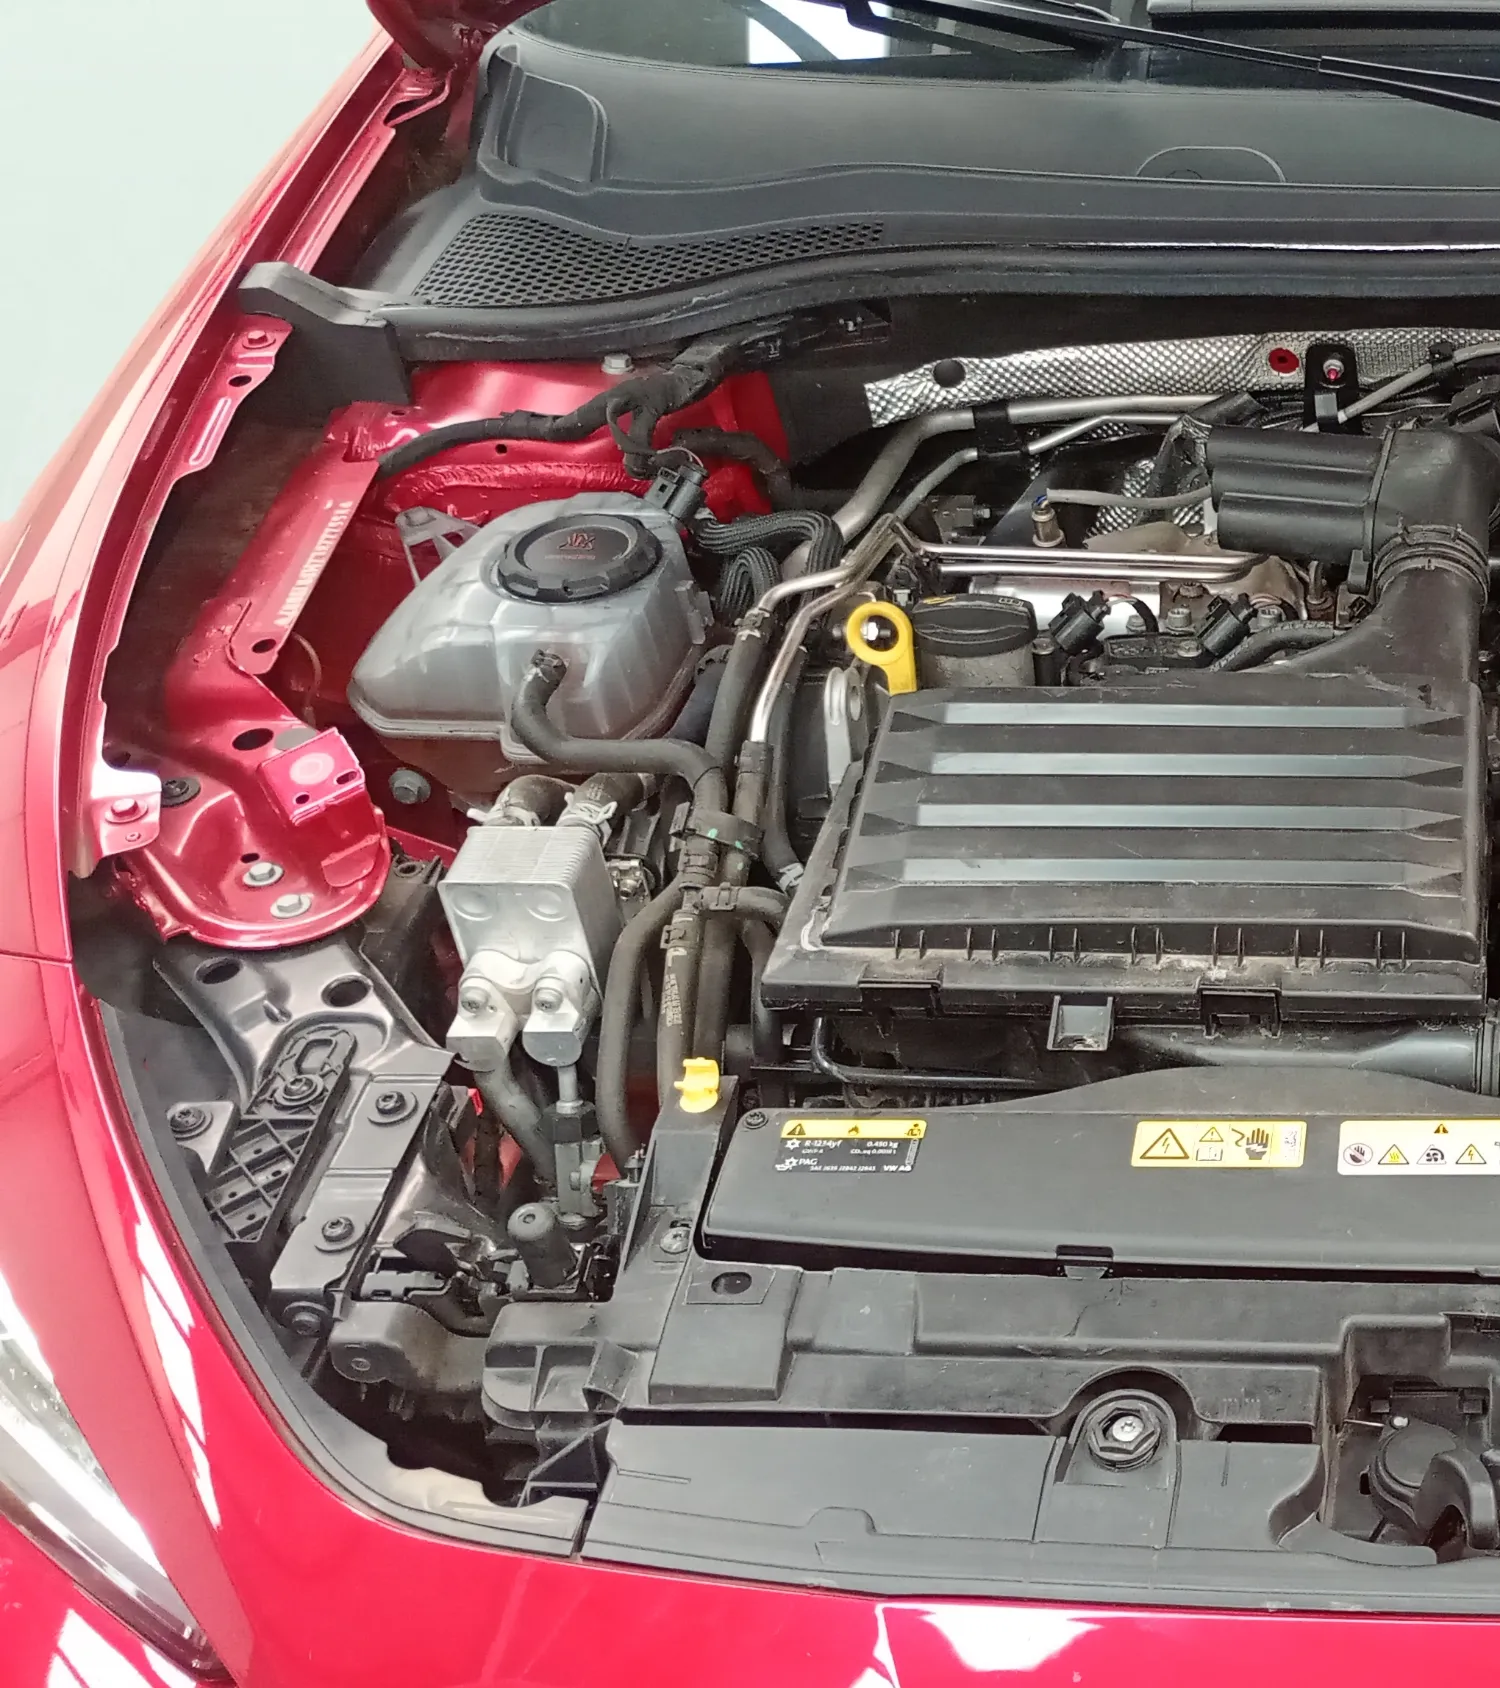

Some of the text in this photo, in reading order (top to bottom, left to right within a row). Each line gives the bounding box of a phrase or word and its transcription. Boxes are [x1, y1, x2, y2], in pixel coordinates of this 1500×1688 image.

[804, 1139, 843, 1149] R-1234yf
[889, 1141, 899, 1149] kg
[798, 1158, 818, 1166] PAG
